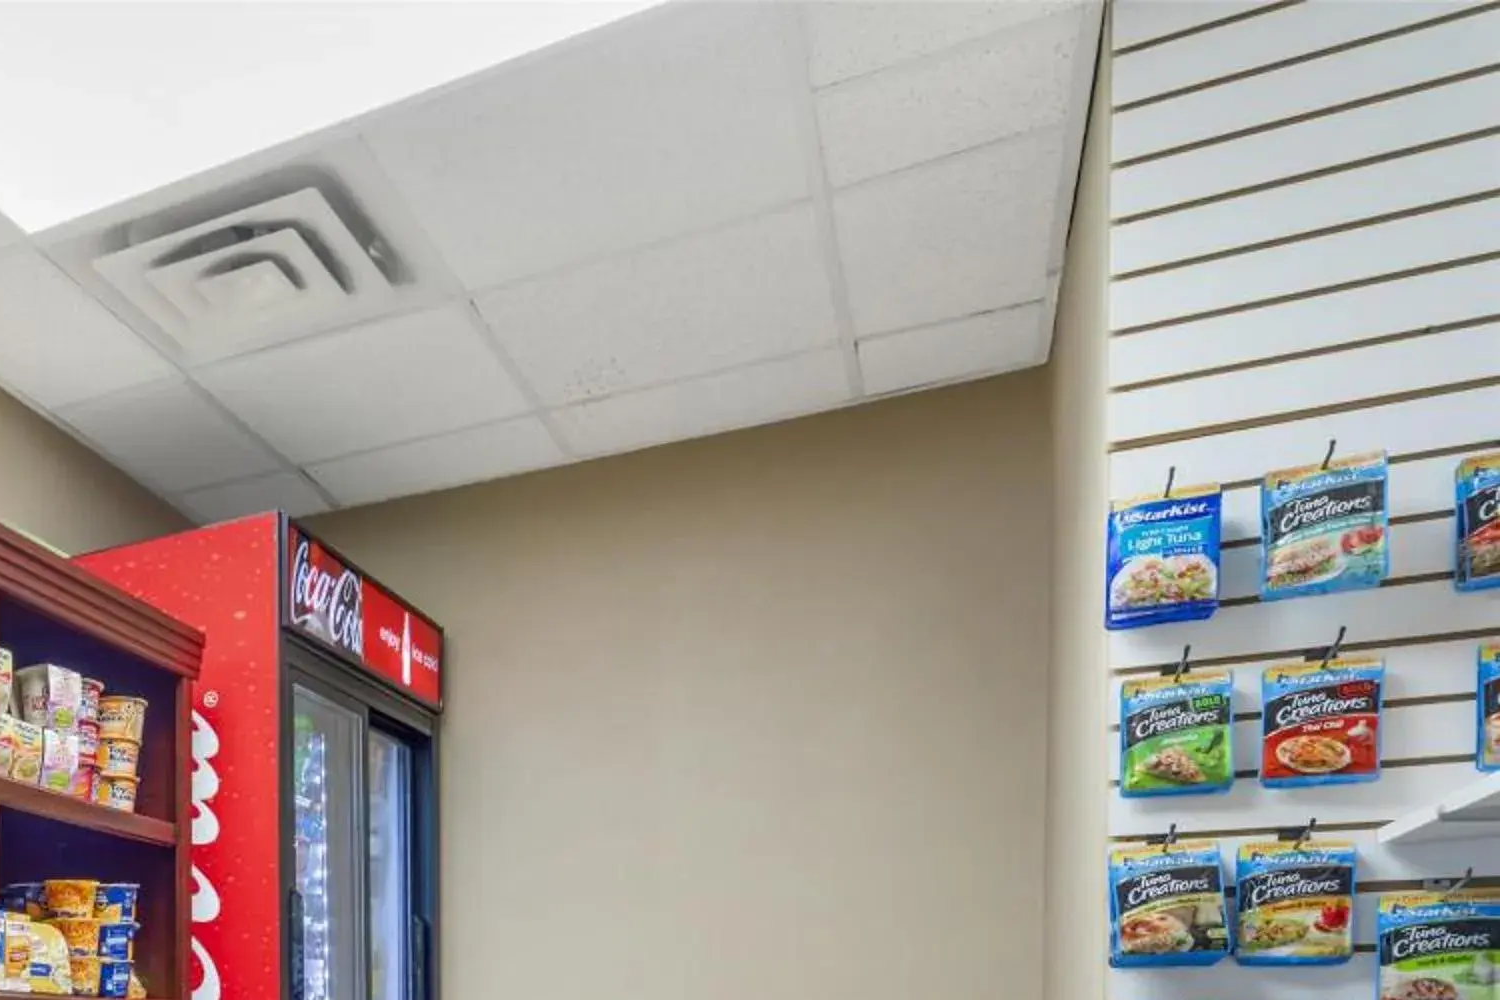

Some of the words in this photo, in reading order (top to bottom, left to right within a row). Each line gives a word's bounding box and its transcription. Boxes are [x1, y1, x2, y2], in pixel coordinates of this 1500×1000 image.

[1281, 496, 1372, 533] Creations
[1166, 530, 1203, 543] Tuna
[1136, 710, 1218, 738] Creations
[1276, 697, 1367, 725] Creations
[1128, 878, 1209, 905] Creations
[1252, 879, 1340, 903] Creations
[1393, 933, 1492, 958] Creations
